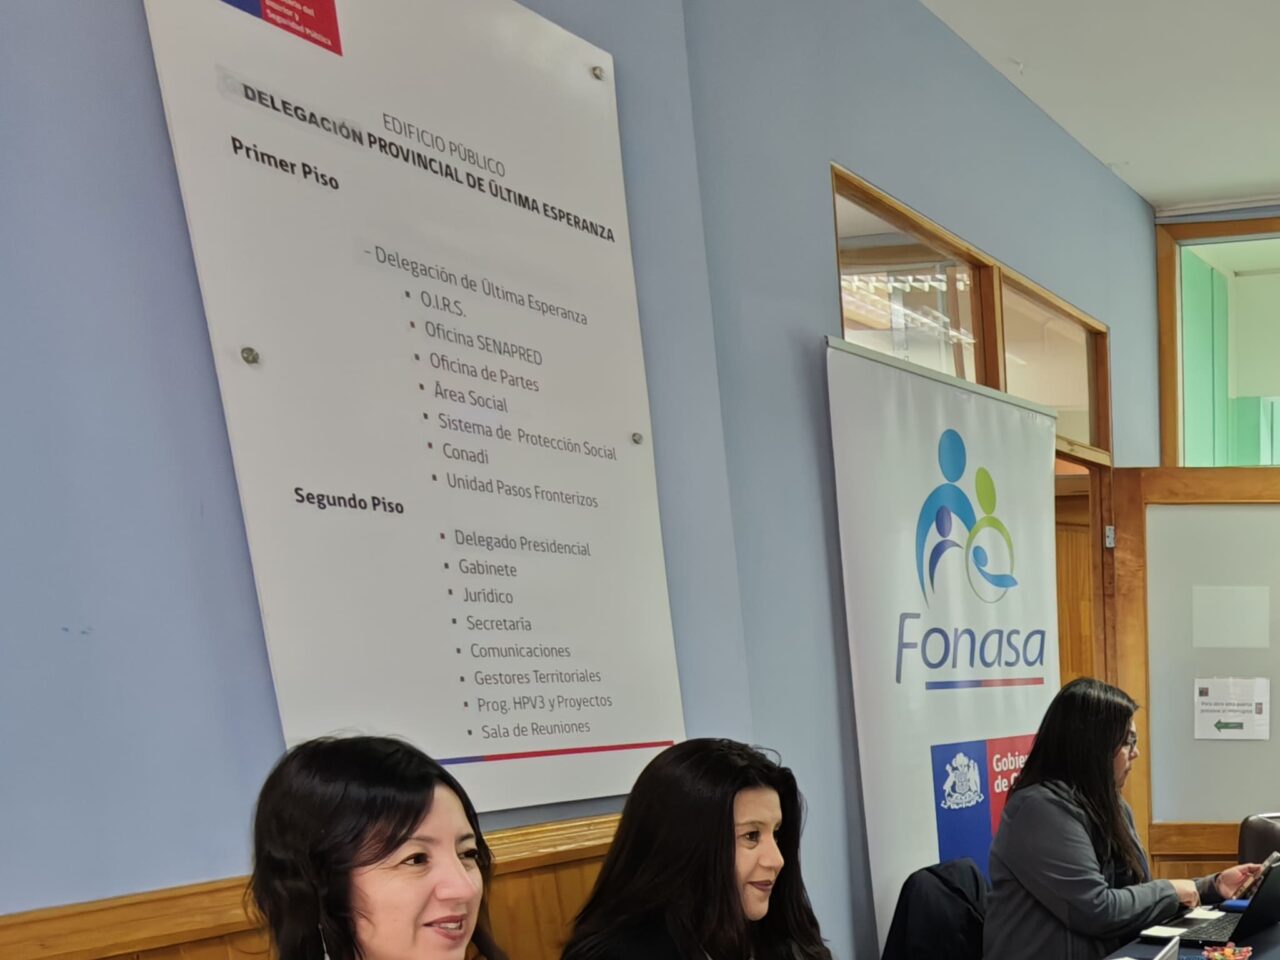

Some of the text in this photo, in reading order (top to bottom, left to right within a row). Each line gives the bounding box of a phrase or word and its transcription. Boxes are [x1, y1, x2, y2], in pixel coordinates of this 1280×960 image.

[383, 112, 506, 178] EDIFICIO PÚBLICO
[230, 135, 339, 190] Primer Piso
[242, 83, 616, 244] DELEGACIÓN PROVINCIAL DE ÚLTIMA ESPERANZA
[375, 246, 588, 326] Delegación de Última Esperanza
[420, 290, 467, 318] O.I.R.S.
[425, 321, 544, 366] Oficina SENAPRED
[429, 352, 540, 393] Oficina de Partes
[434, 380, 509, 413] Área Social
[438, 413, 617, 461] Sistema de Protección Social
[442, 442, 489, 465] Conadi
[293, 487, 405, 514] Segundo Piso
[446, 472, 599, 509] Unidad Pasos Fronterizos
[454, 529, 592, 557] Delegado Presidencial
[458, 558, 518, 578] Gabinete
[470, 643, 572, 658] Comunicaciones
[896, 612, 1046, 684] Fonasa
[474, 668, 602, 686] Gestores Territoriales
[477, 694, 613, 715] Prog. HPV3 y Proyectos
[481, 720, 591, 740] Sala de Reuniones
[994, 775, 1009, 793] de
